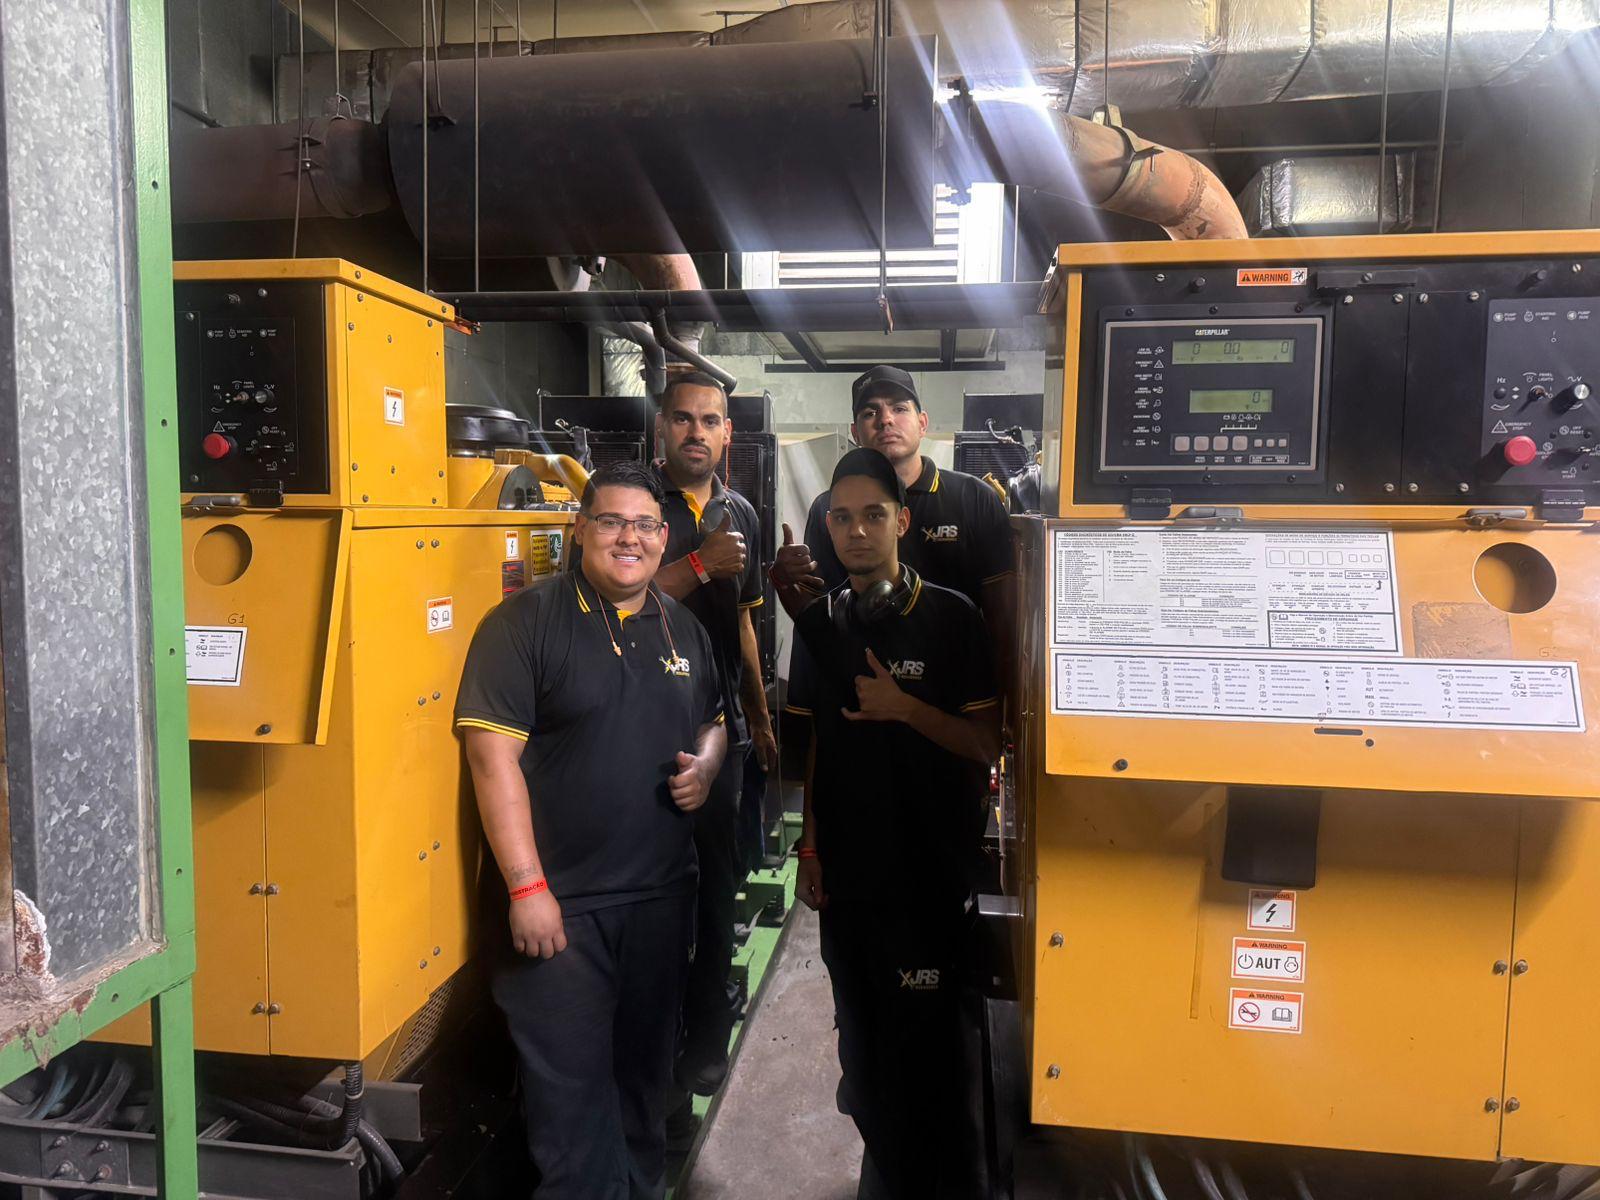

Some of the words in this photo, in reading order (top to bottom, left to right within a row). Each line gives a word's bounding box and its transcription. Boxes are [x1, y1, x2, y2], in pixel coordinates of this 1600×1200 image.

[1251, 273, 1289, 282] WARNING
[932, 525, 958, 538] JRS
[227, 613, 245, 625] G1
[896, 660, 926, 675] JRS
[1550, 667, 1568, 679] G2
[1255, 957, 1281, 970] AUT
[909, 968, 940, 985] JRS
